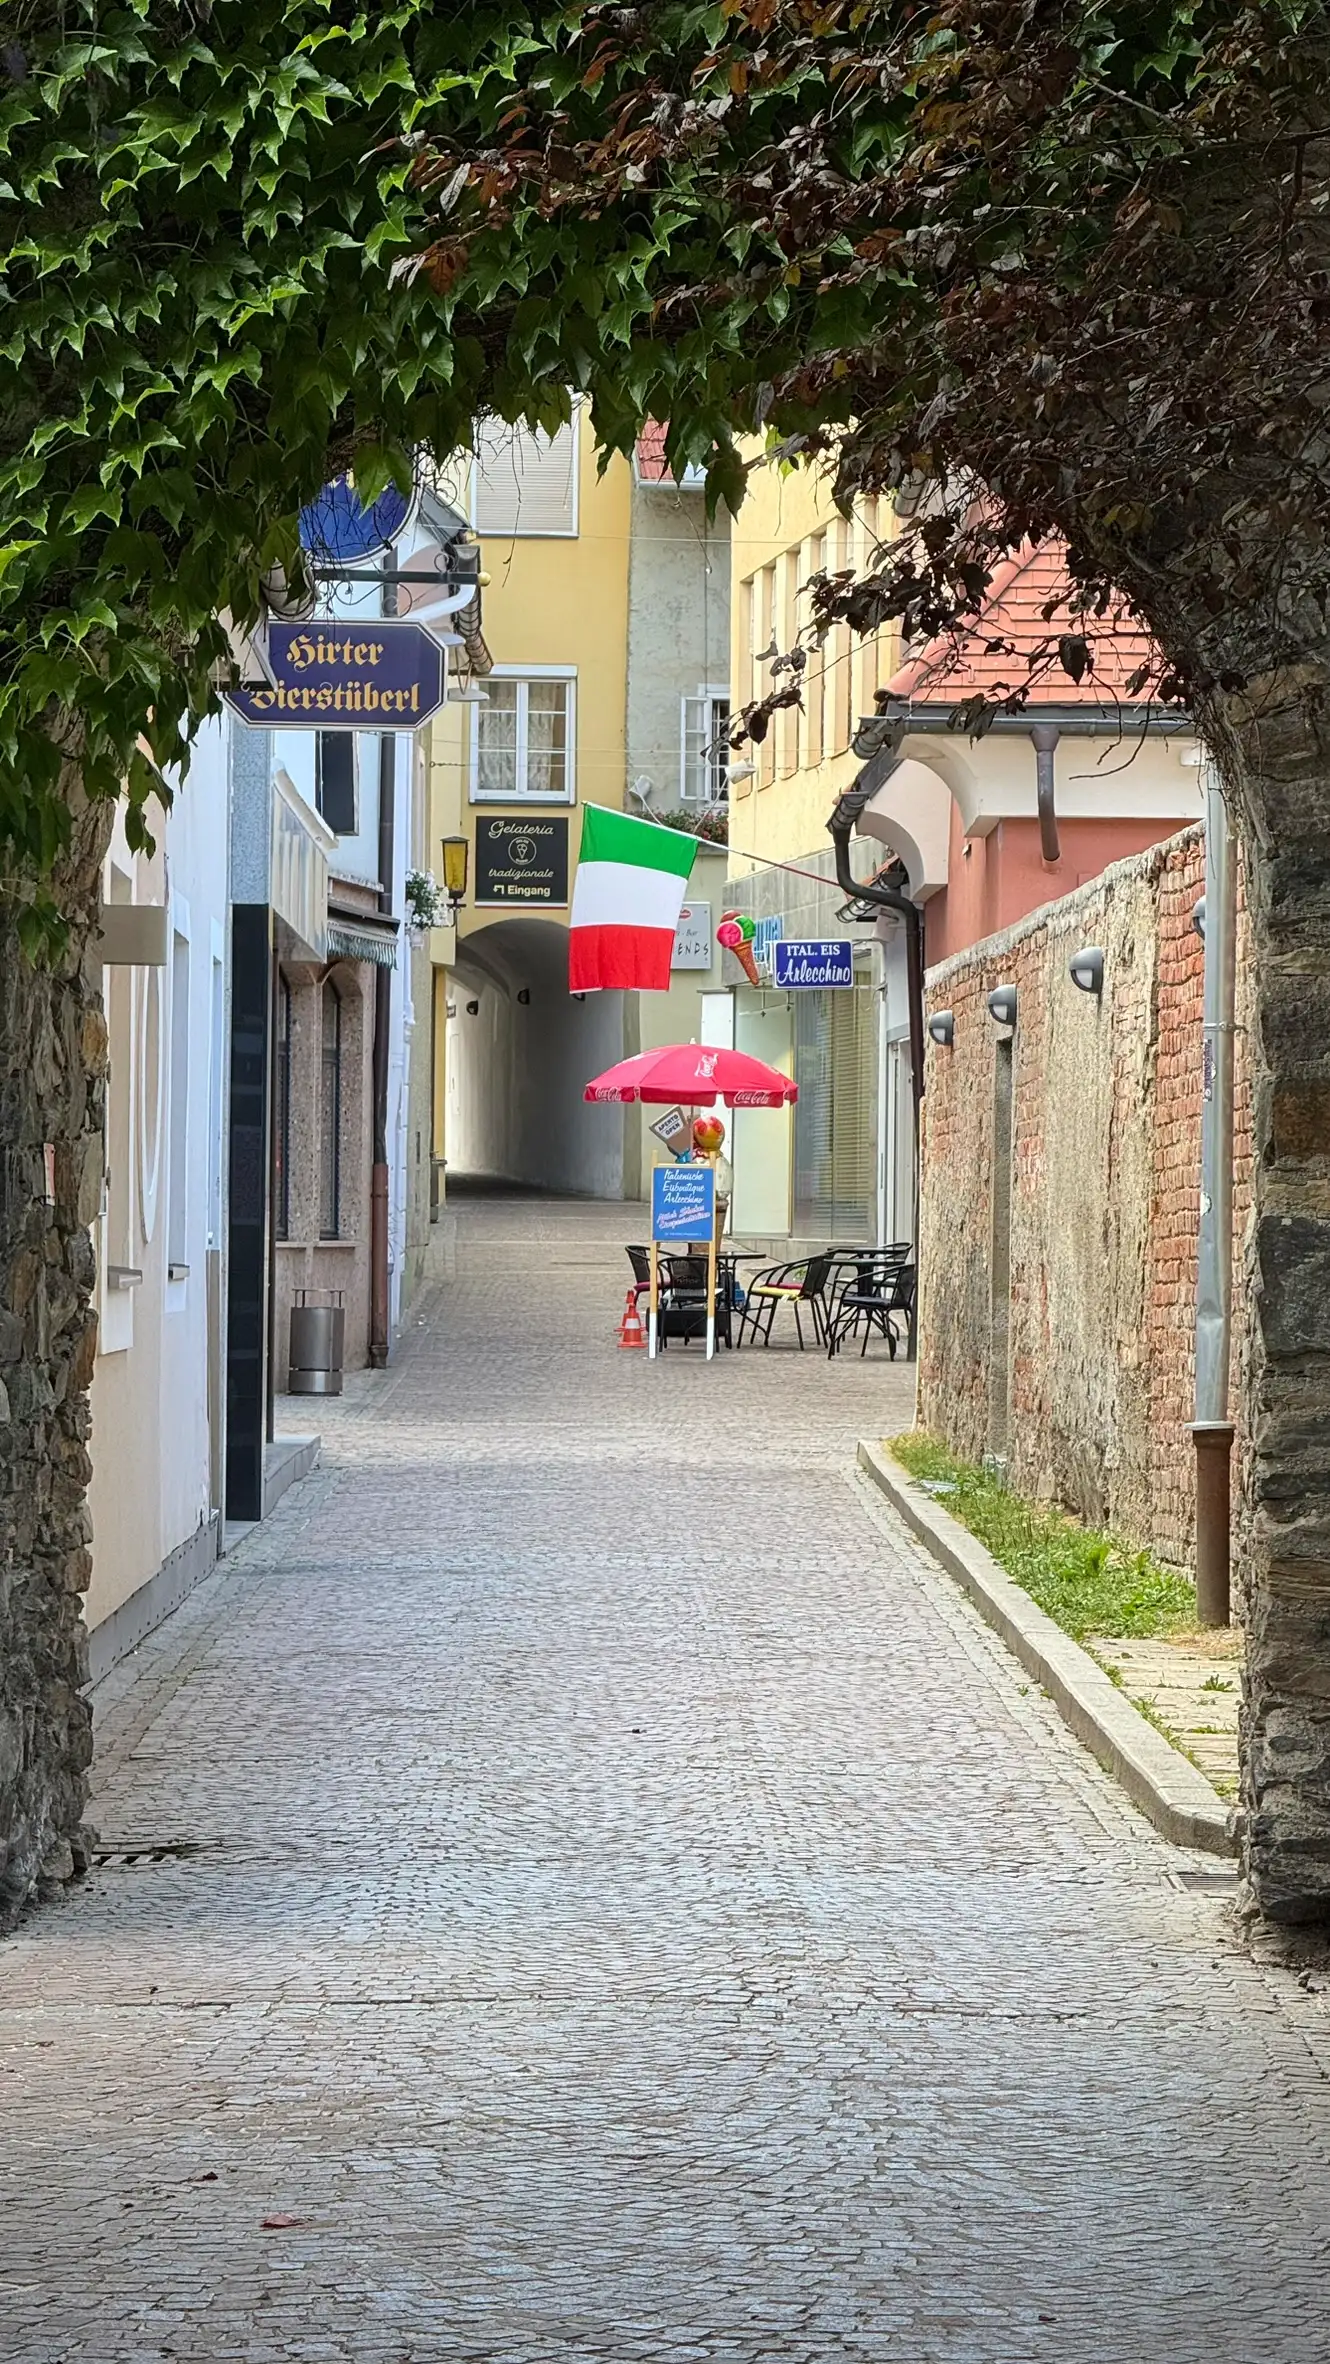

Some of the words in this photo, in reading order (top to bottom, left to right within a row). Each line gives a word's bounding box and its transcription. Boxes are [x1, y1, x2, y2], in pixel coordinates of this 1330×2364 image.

[286, 634, 384, 672] Hirter
[248, 680, 421, 713] Bierstüberl
[488, 820, 554, 839] Gelateria
[488, 868, 554, 880] tradizionale
[507, 884, 551, 897] Eingang
[677, 941, 709, 955] ENDS
[786, 944, 818, 956] ITAL.
[820, 944, 841, 956] EIS
[777, 958, 850, 984] Arlecchino
[665, 1122, 680, 1136] OPEN
[663, 1168, 704, 1181] Italienische
[662, 1180, 705, 1195] Eisboutique
[663, 1192, 705, 1204] Arlecchino
